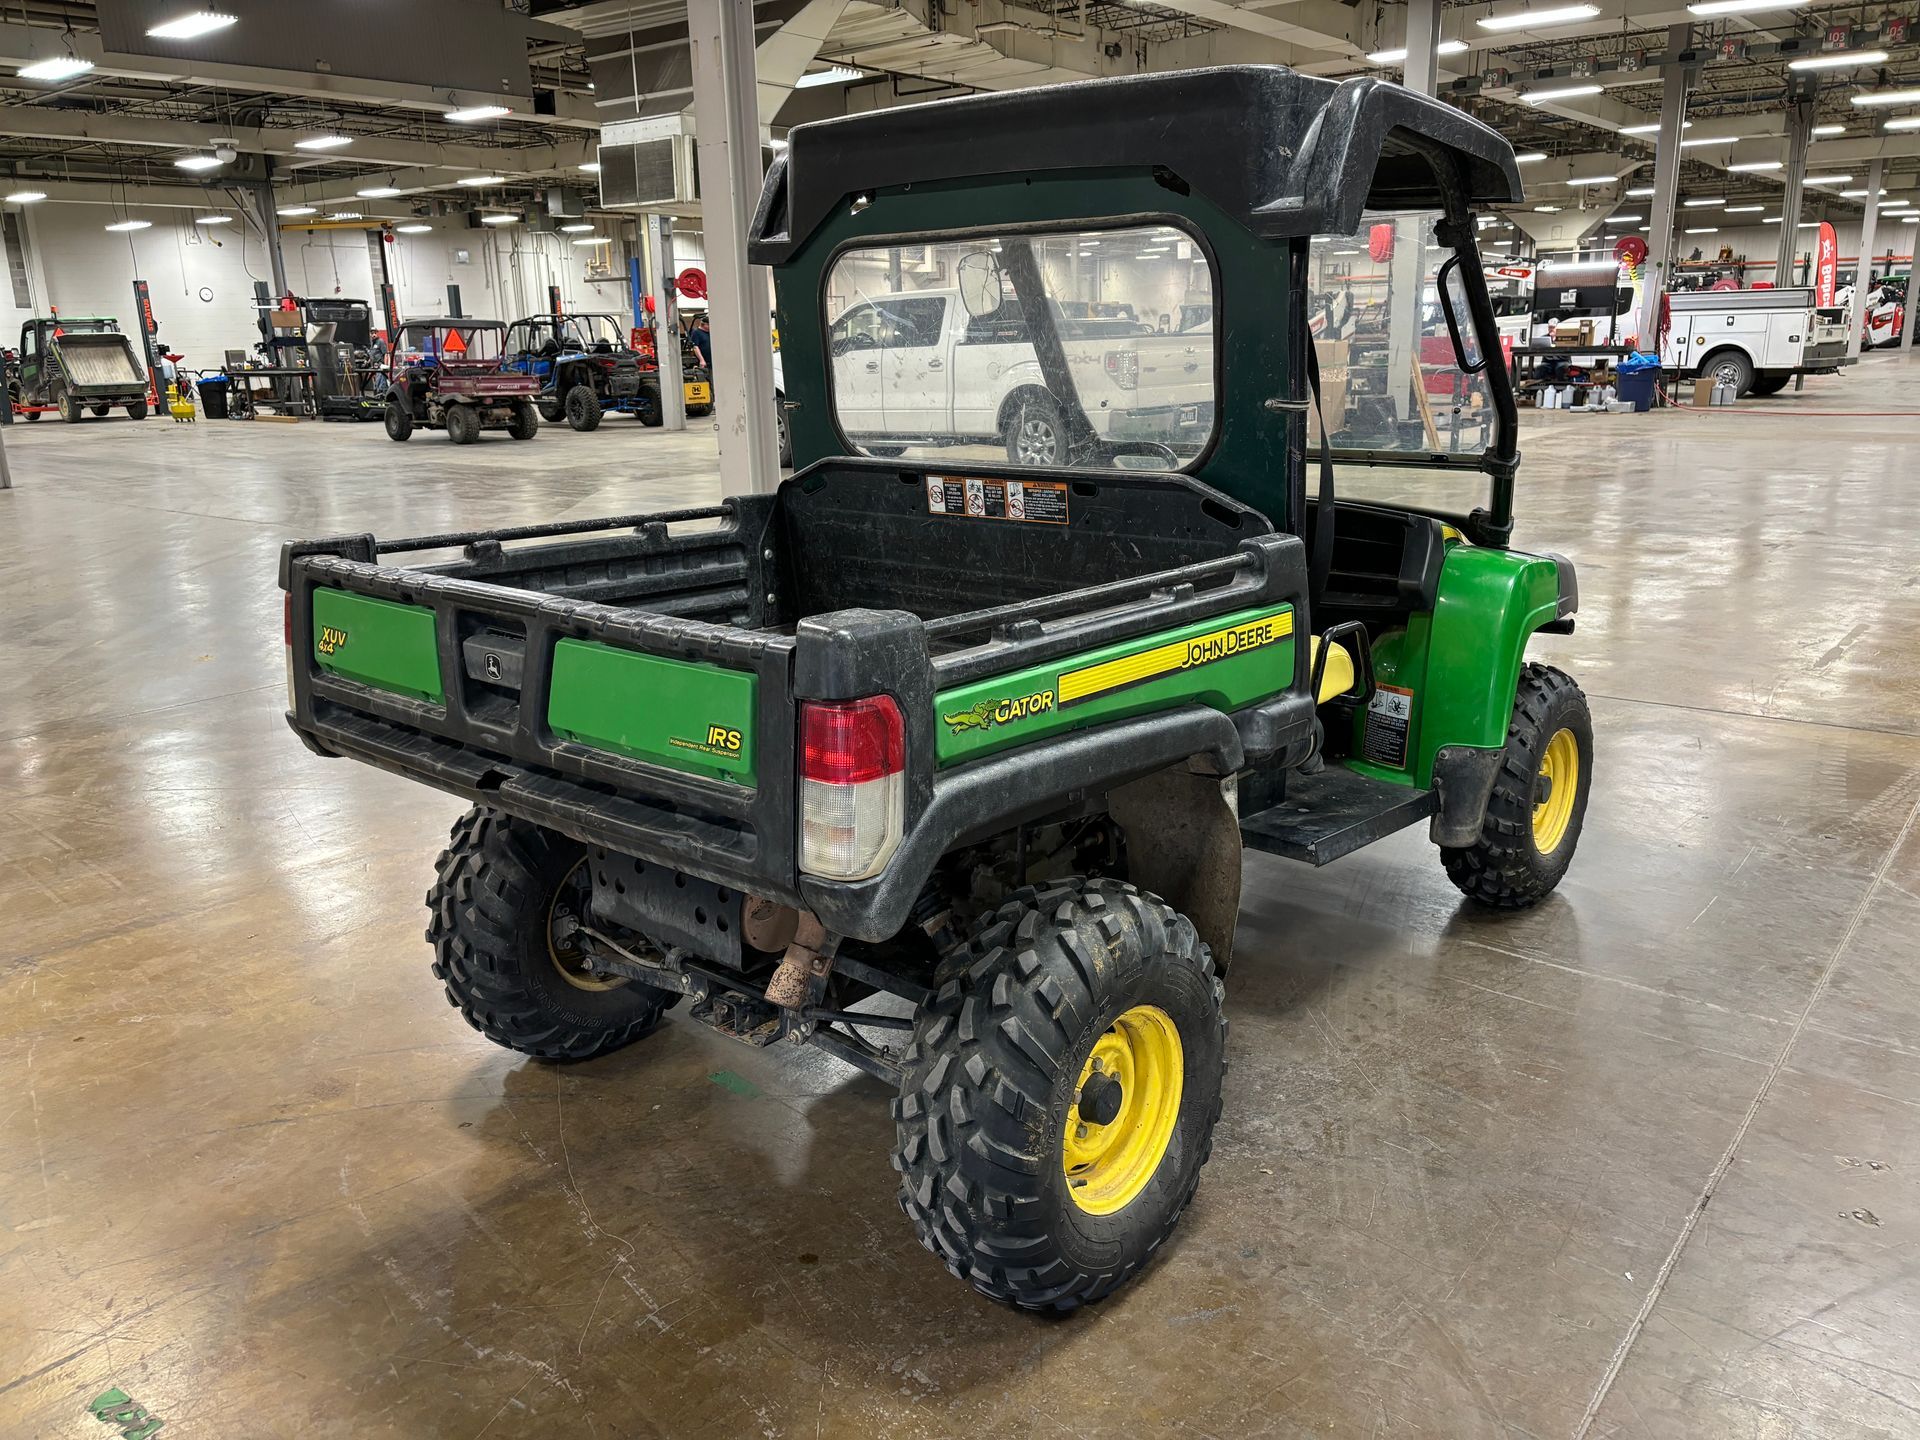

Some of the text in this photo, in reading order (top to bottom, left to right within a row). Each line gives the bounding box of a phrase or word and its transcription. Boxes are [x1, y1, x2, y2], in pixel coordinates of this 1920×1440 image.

[1828, 32, 1845, 42] 103
[1887, 26, 1904, 37] 105
[1722, 44, 1736, 54] 99
[1576, 61, 1587, 71] 93
[1623, 57, 1635, 67] 95
[1487, 72, 1498, 82] 89
[143, 298, 154, 332] STRATUS
[321, 626, 348, 647] XUV
[318, 640, 335, 654] 4x4
[1181, 622, 1274, 668] JOHN DEERE
[994, 690, 1054, 725] GATOR
[707, 726, 742, 750] IRS
[669, 738, 740, 758] Independent Rear Suspension
